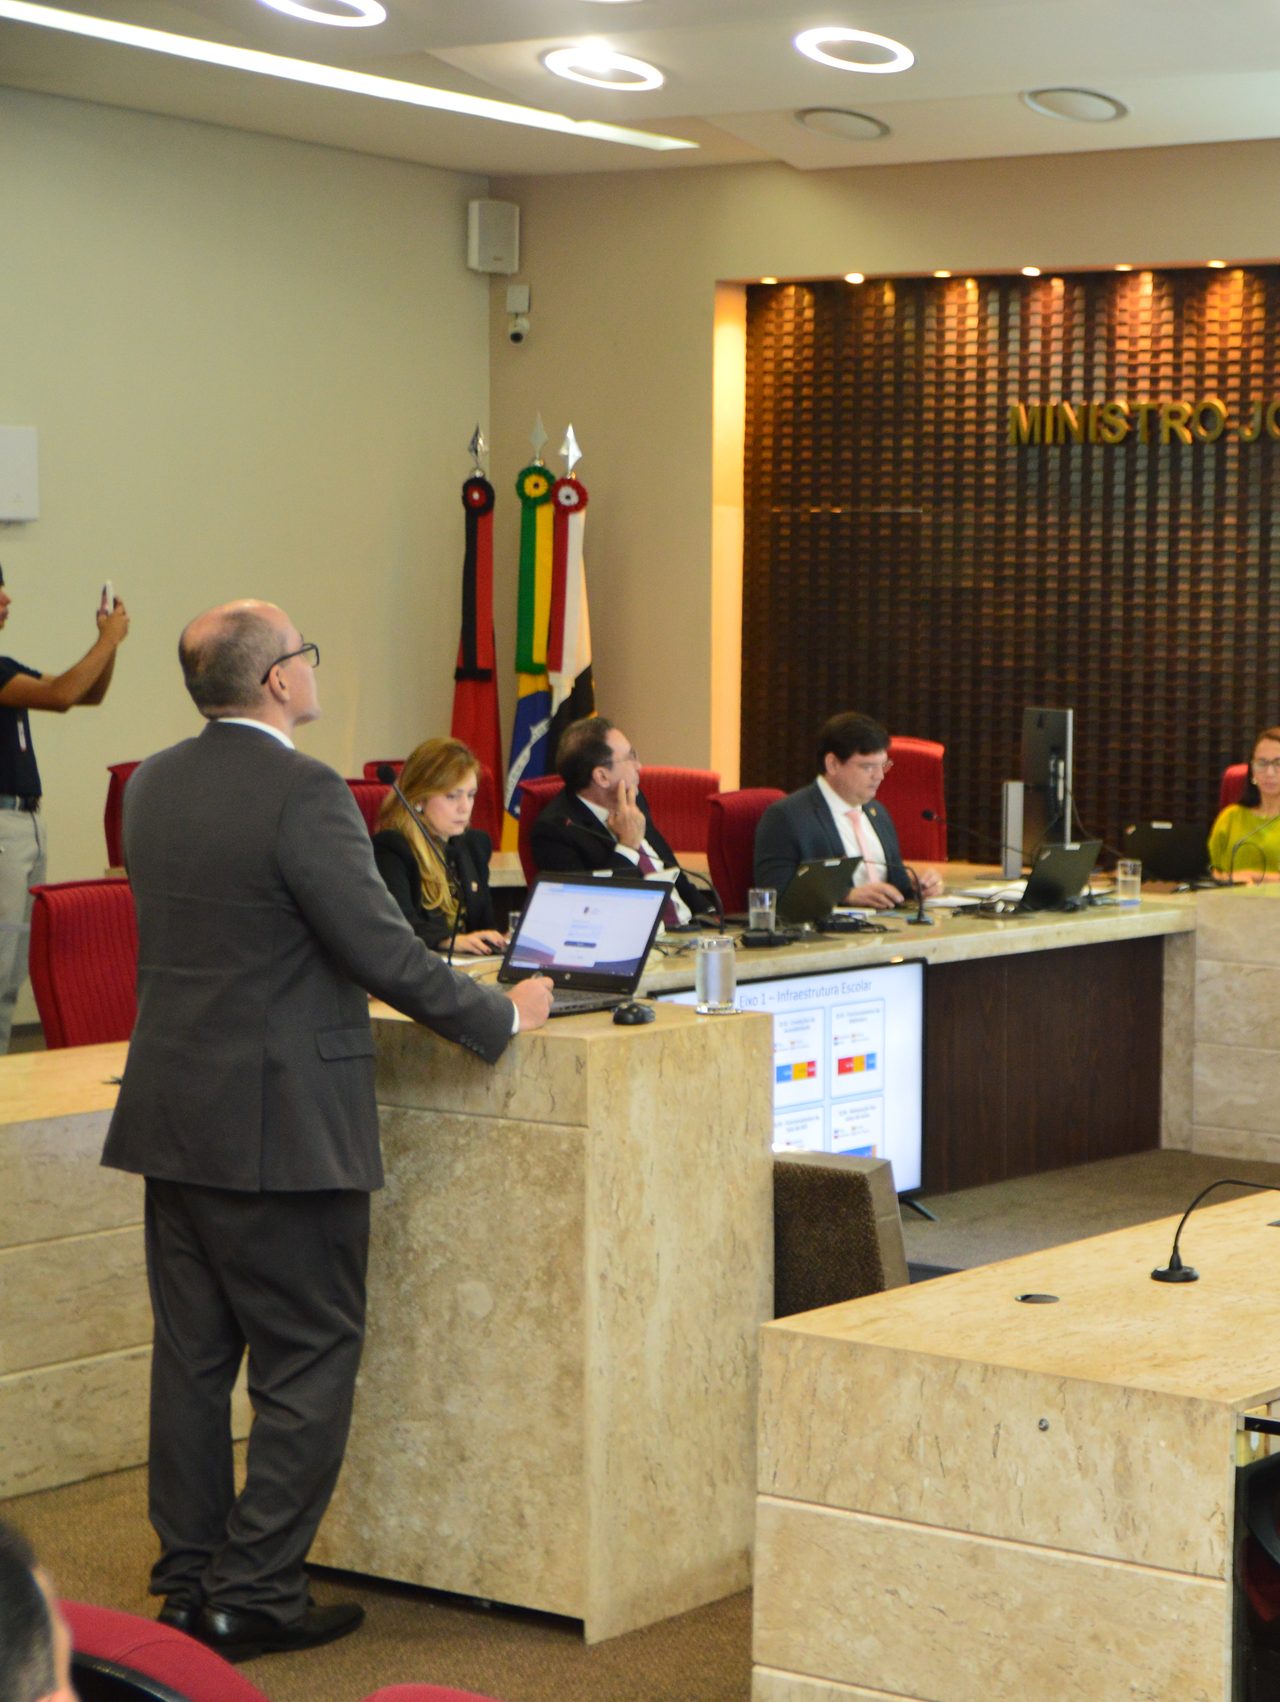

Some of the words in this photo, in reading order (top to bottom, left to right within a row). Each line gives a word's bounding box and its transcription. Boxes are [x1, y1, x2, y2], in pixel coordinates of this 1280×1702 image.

[1007, 397, 1227, 445] MINISTRO
[739, 993, 759, 1008] Eixo
[777, 983, 840, 1003] Infraestrutura
[841, 979, 872, 995] Escolar
